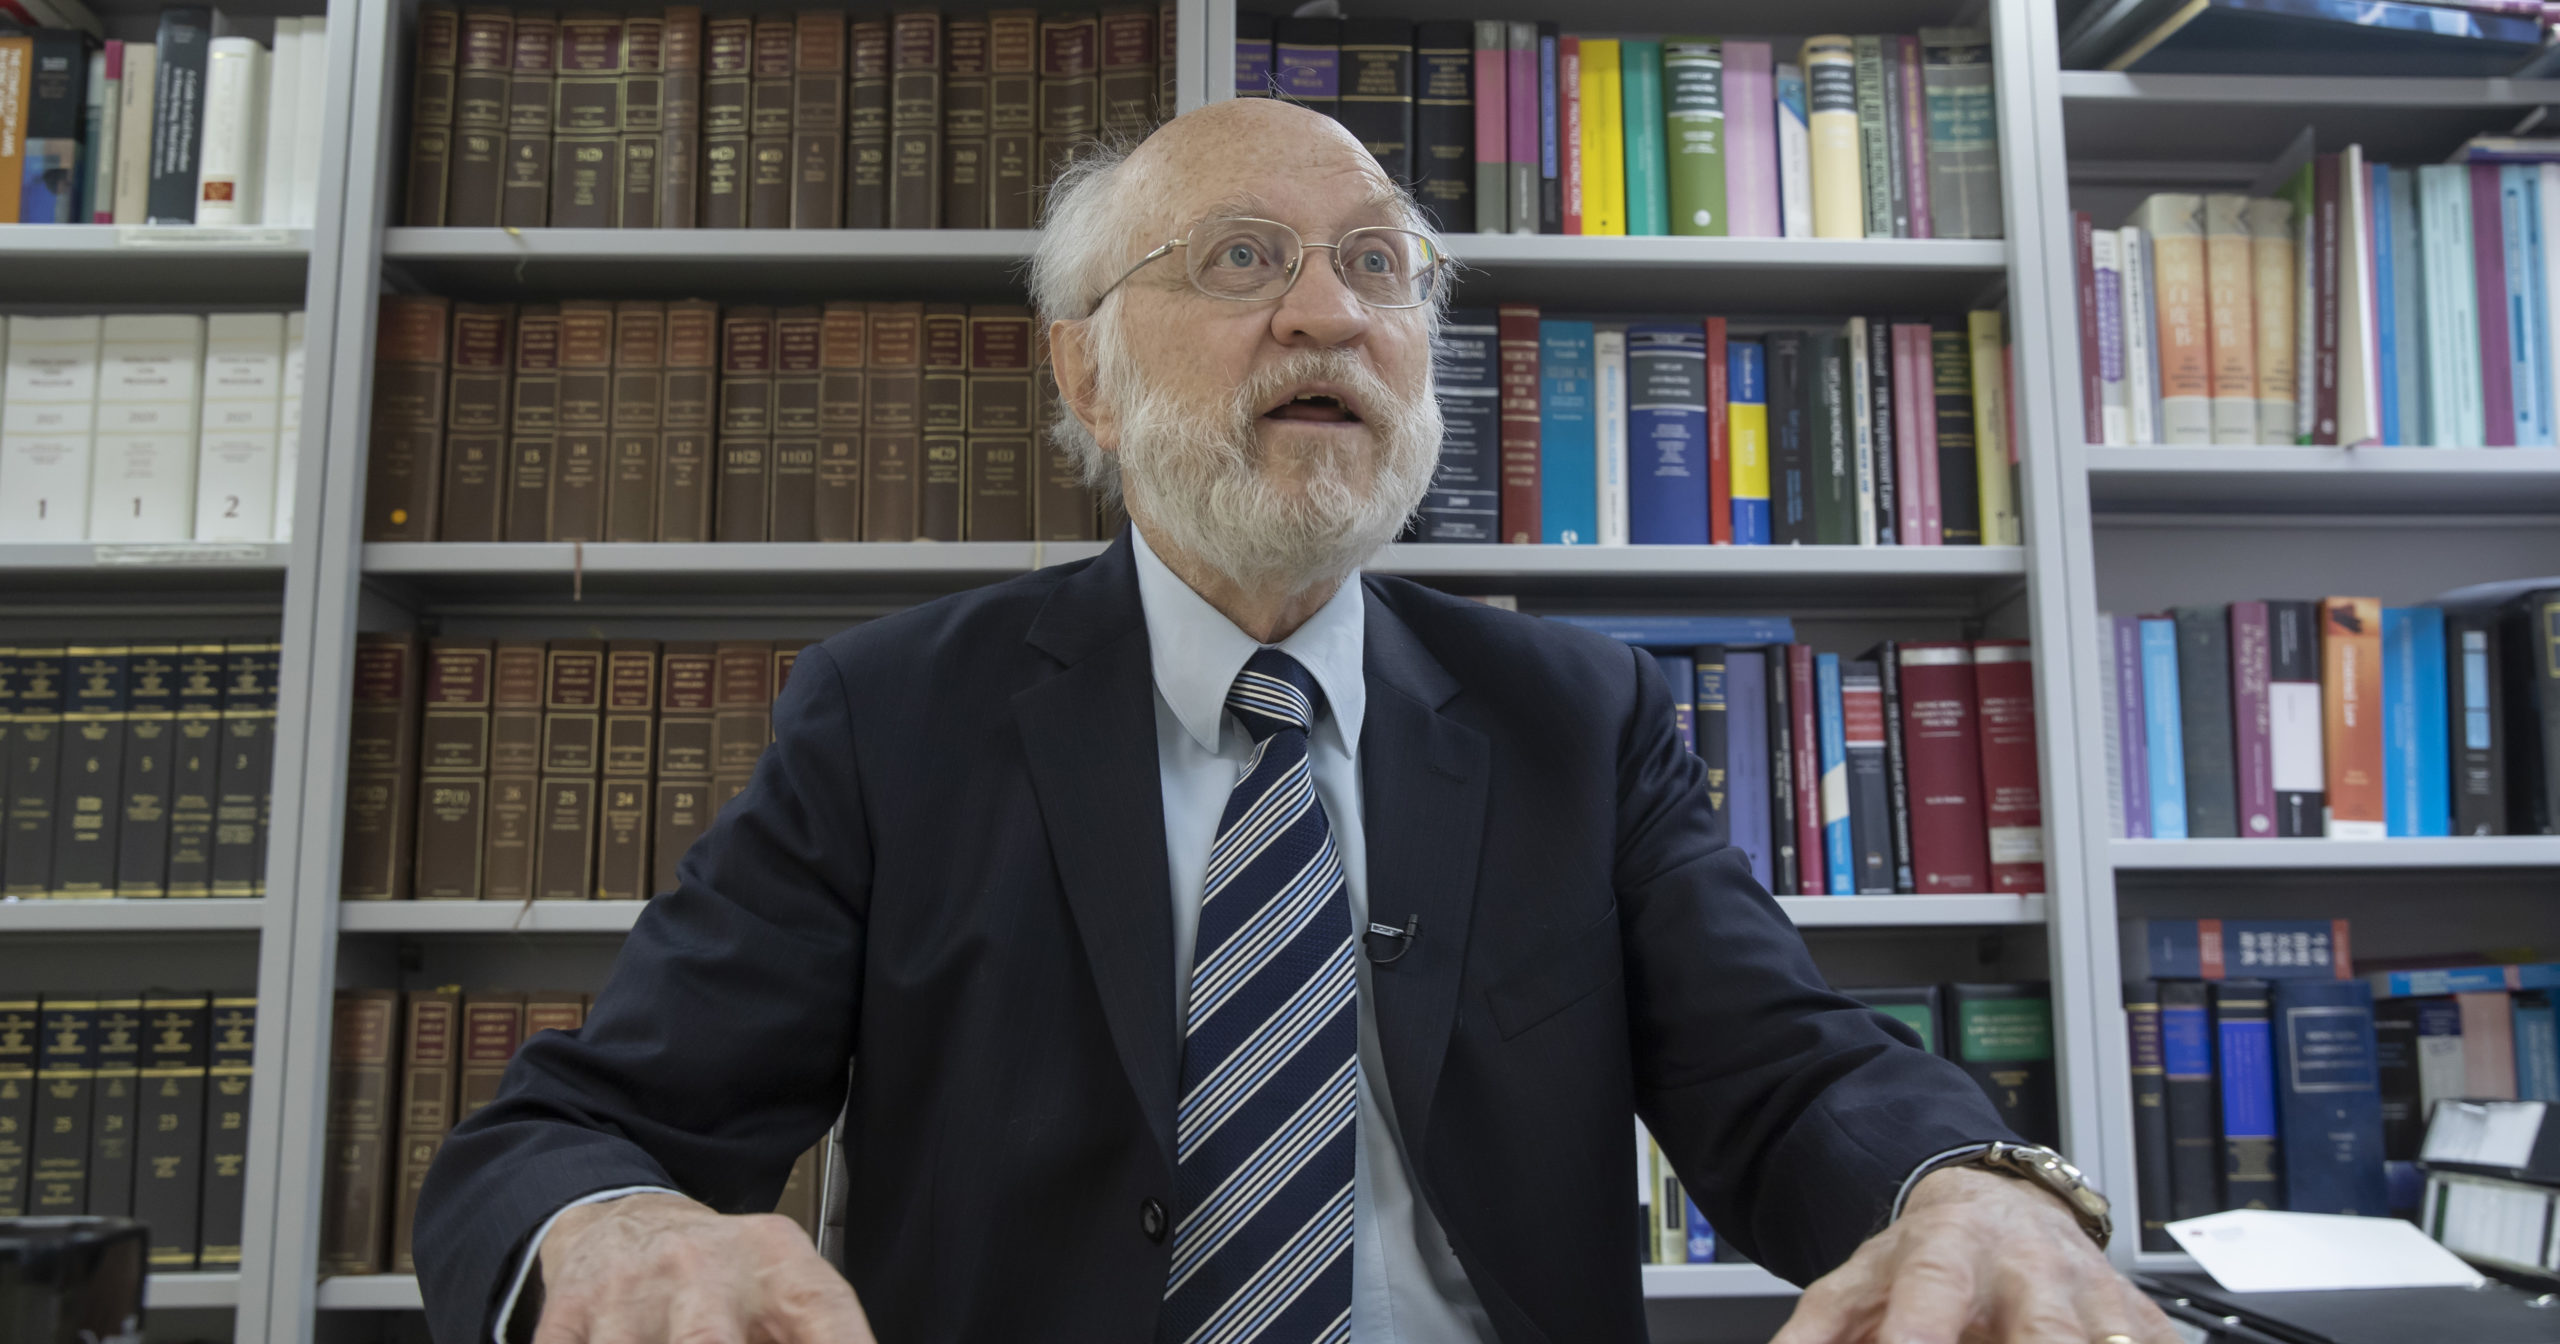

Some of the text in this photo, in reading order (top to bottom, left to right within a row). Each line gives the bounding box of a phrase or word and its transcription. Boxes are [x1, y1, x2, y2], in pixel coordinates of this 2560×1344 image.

[1873, 410, 1891, 483] Employment
[134, 497, 141, 518] 1
[223, 495, 239, 518] 2
[1879, 484, 1893, 511] Law
[39, 499, 47, 520] 1
